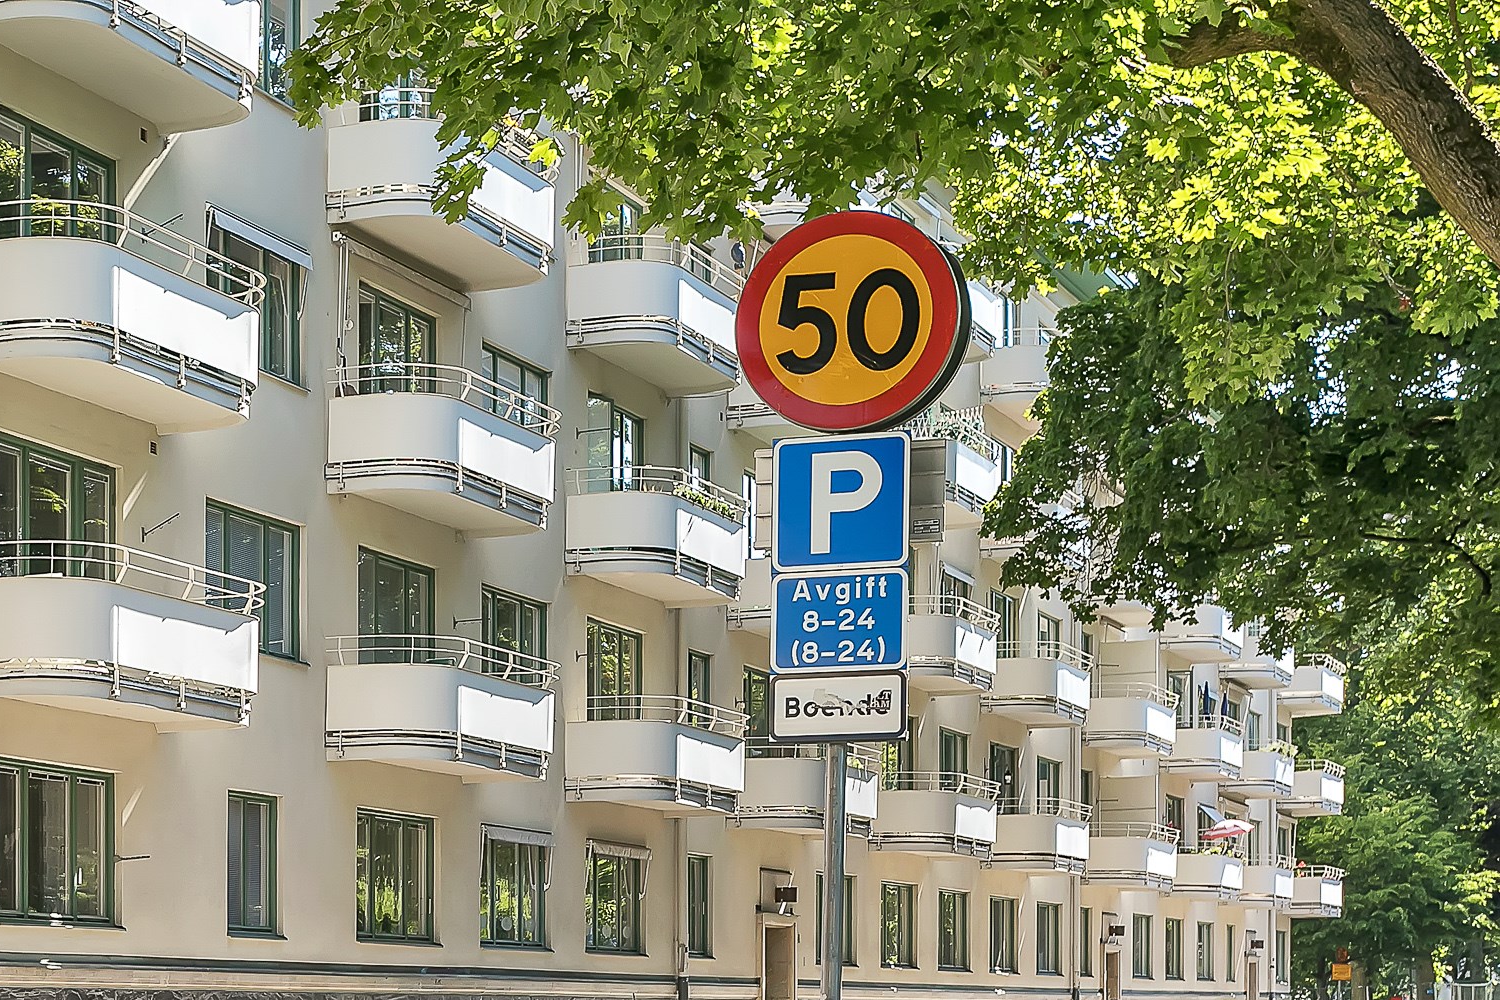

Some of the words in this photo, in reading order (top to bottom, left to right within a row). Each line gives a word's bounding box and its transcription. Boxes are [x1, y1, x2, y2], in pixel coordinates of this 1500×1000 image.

[776, 268, 920, 375] 50
[810, 451, 883, 555] P
[791, 576, 887, 605] Avgift
[802, 608, 875, 632] 8-24
[791, 636, 886, 667] (8-24)
